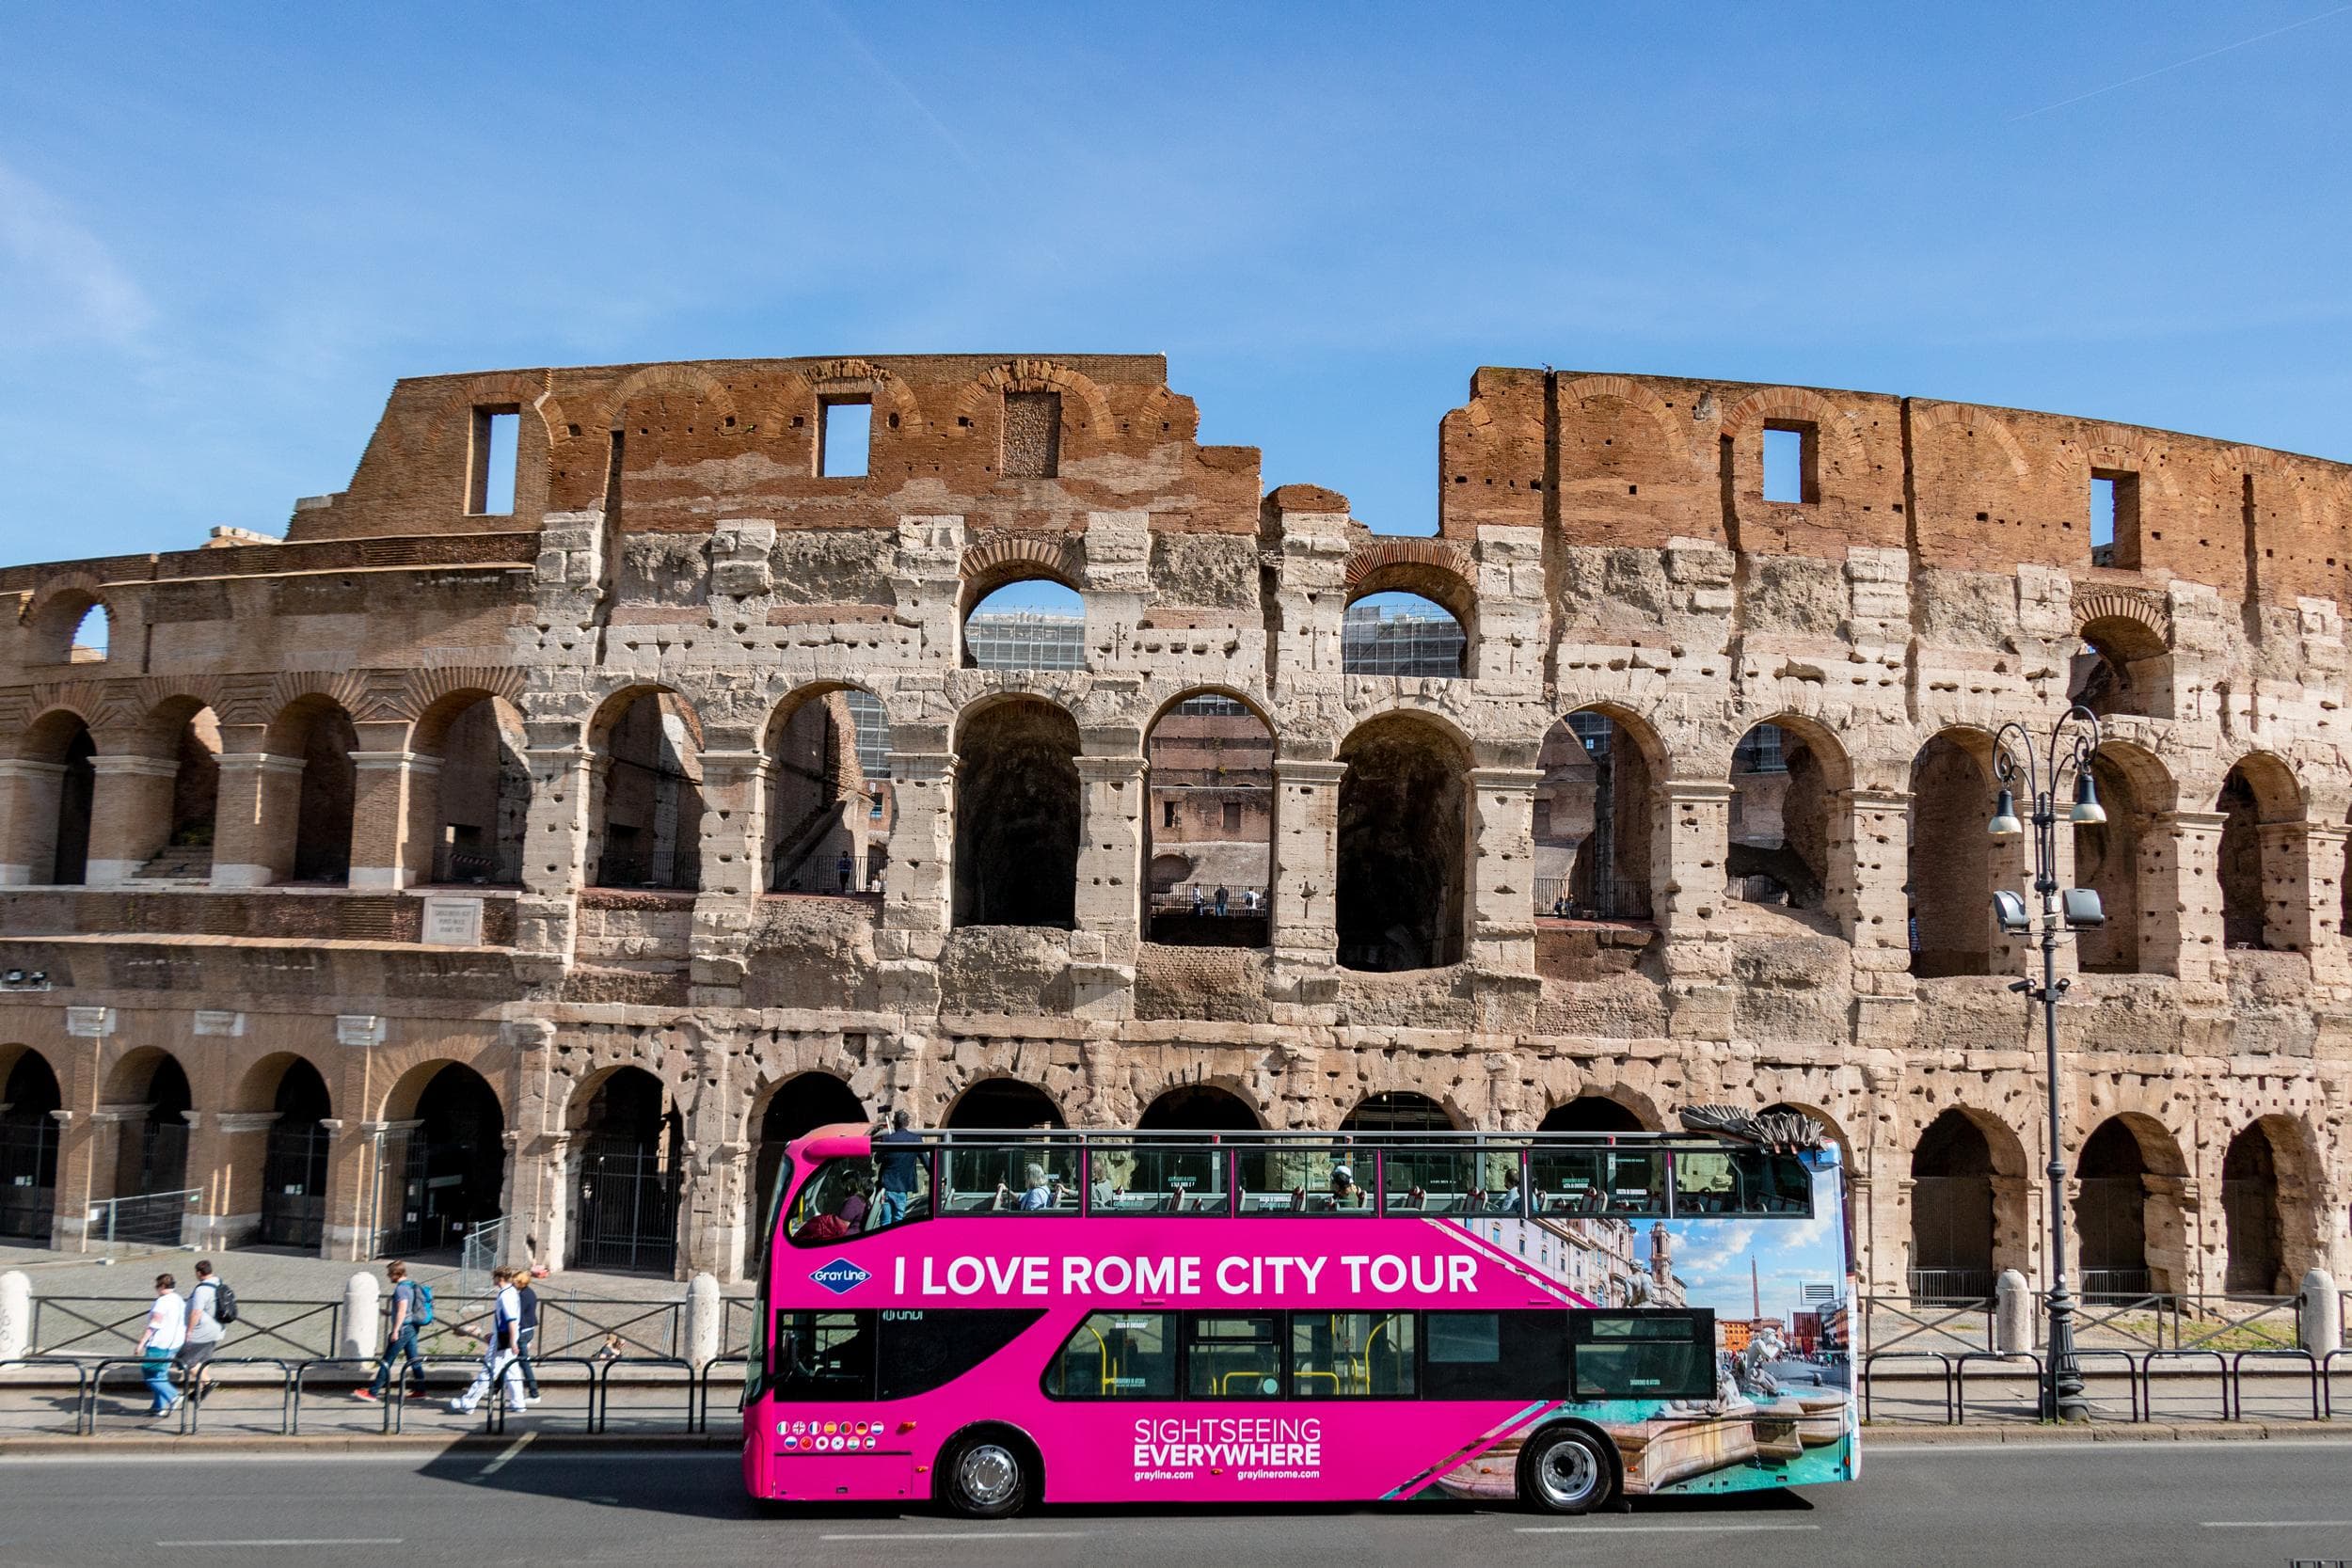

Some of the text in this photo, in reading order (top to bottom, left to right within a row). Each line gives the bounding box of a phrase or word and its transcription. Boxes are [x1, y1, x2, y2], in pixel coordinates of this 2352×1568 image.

[815, 1270, 866, 1281] Gray Line
[894, 1254, 1478, 1295] I LOVE ROME CITY TOUR
[1135, 1418, 1321, 1444] SIGHTSEEING
[1134, 1443, 1321, 1467] EVERYWHERE
[1135, 1469, 1194, 1481] grayline.com
[1237, 1468, 1320, 1481] graylinerome.com
